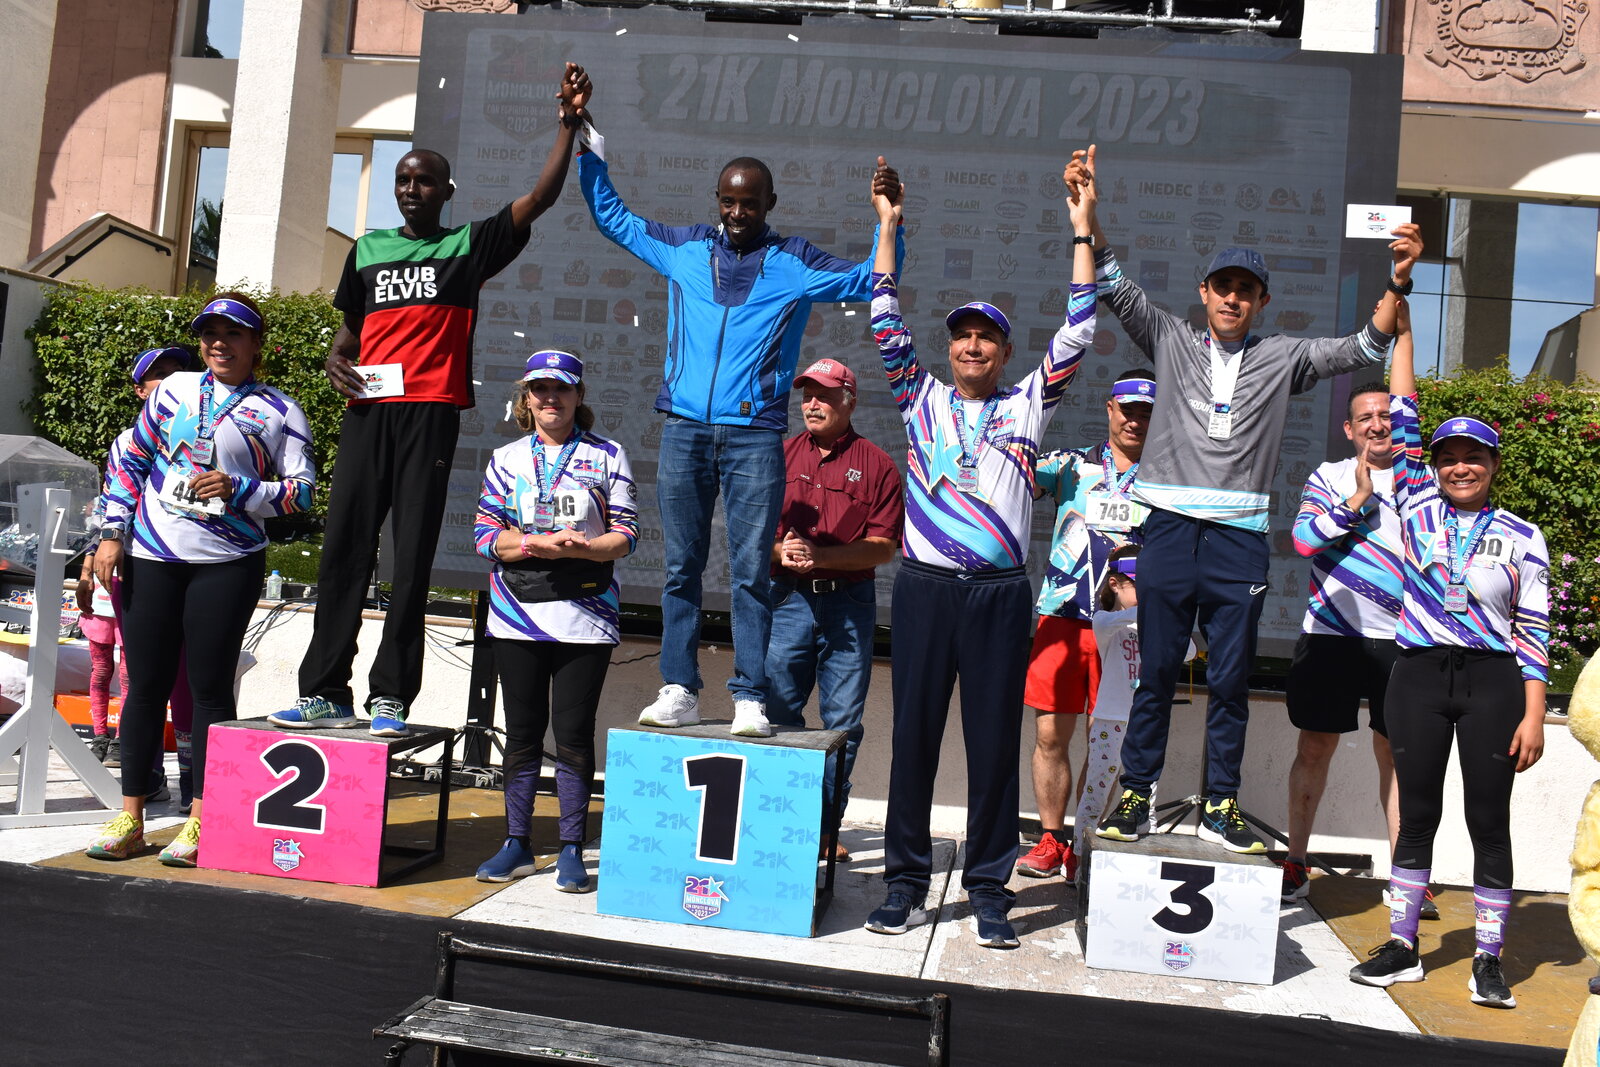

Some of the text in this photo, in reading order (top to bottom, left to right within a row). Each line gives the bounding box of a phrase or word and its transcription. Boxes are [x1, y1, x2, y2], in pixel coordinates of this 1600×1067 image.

[1491, 50, 1518, 67] DE
[657, 54, 1207, 146] 21K MONCLOVA 2023
[507, 116, 538, 133] 2023
[477, 148, 526, 161] INEDEC
[658, 156, 710, 171] INEDEC
[657, 183, 693, 194] CIMARI
[944, 171, 997, 186] INEDEC
[1138, 181, 1193, 197] INEDEC
[943, 199, 981, 211] CIMARI
[1138, 209, 1176, 221] CIMARI
[955, 224, 981, 237] SIKA
[1149, 235, 1177, 248] SIKA
[376, 266, 436, 286] CLUB
[375, 282, 438, 303] ELVIS
[1099, 502, 1130, 521] 743
[254, 739, 329, 834] 2
[632, 779, 673, 801] 21K
[683, 752, 747, 865] 1
[758, 793, 799, 816] 21K
[656, 811, 696, 833] 21K
[626, 833, 669, 856] 21K
[781, 825, 819, 846] 21K
[752, 849, 794, 873] 21K
[1094, 852, 1123, 873] 1K
[1221, 866, 1266, 887] 21K
[1117, 882, 1163, 905] 21K
[1152, 861, 1216, 934] 3
[1216, 921, 1261, 945] 21K
